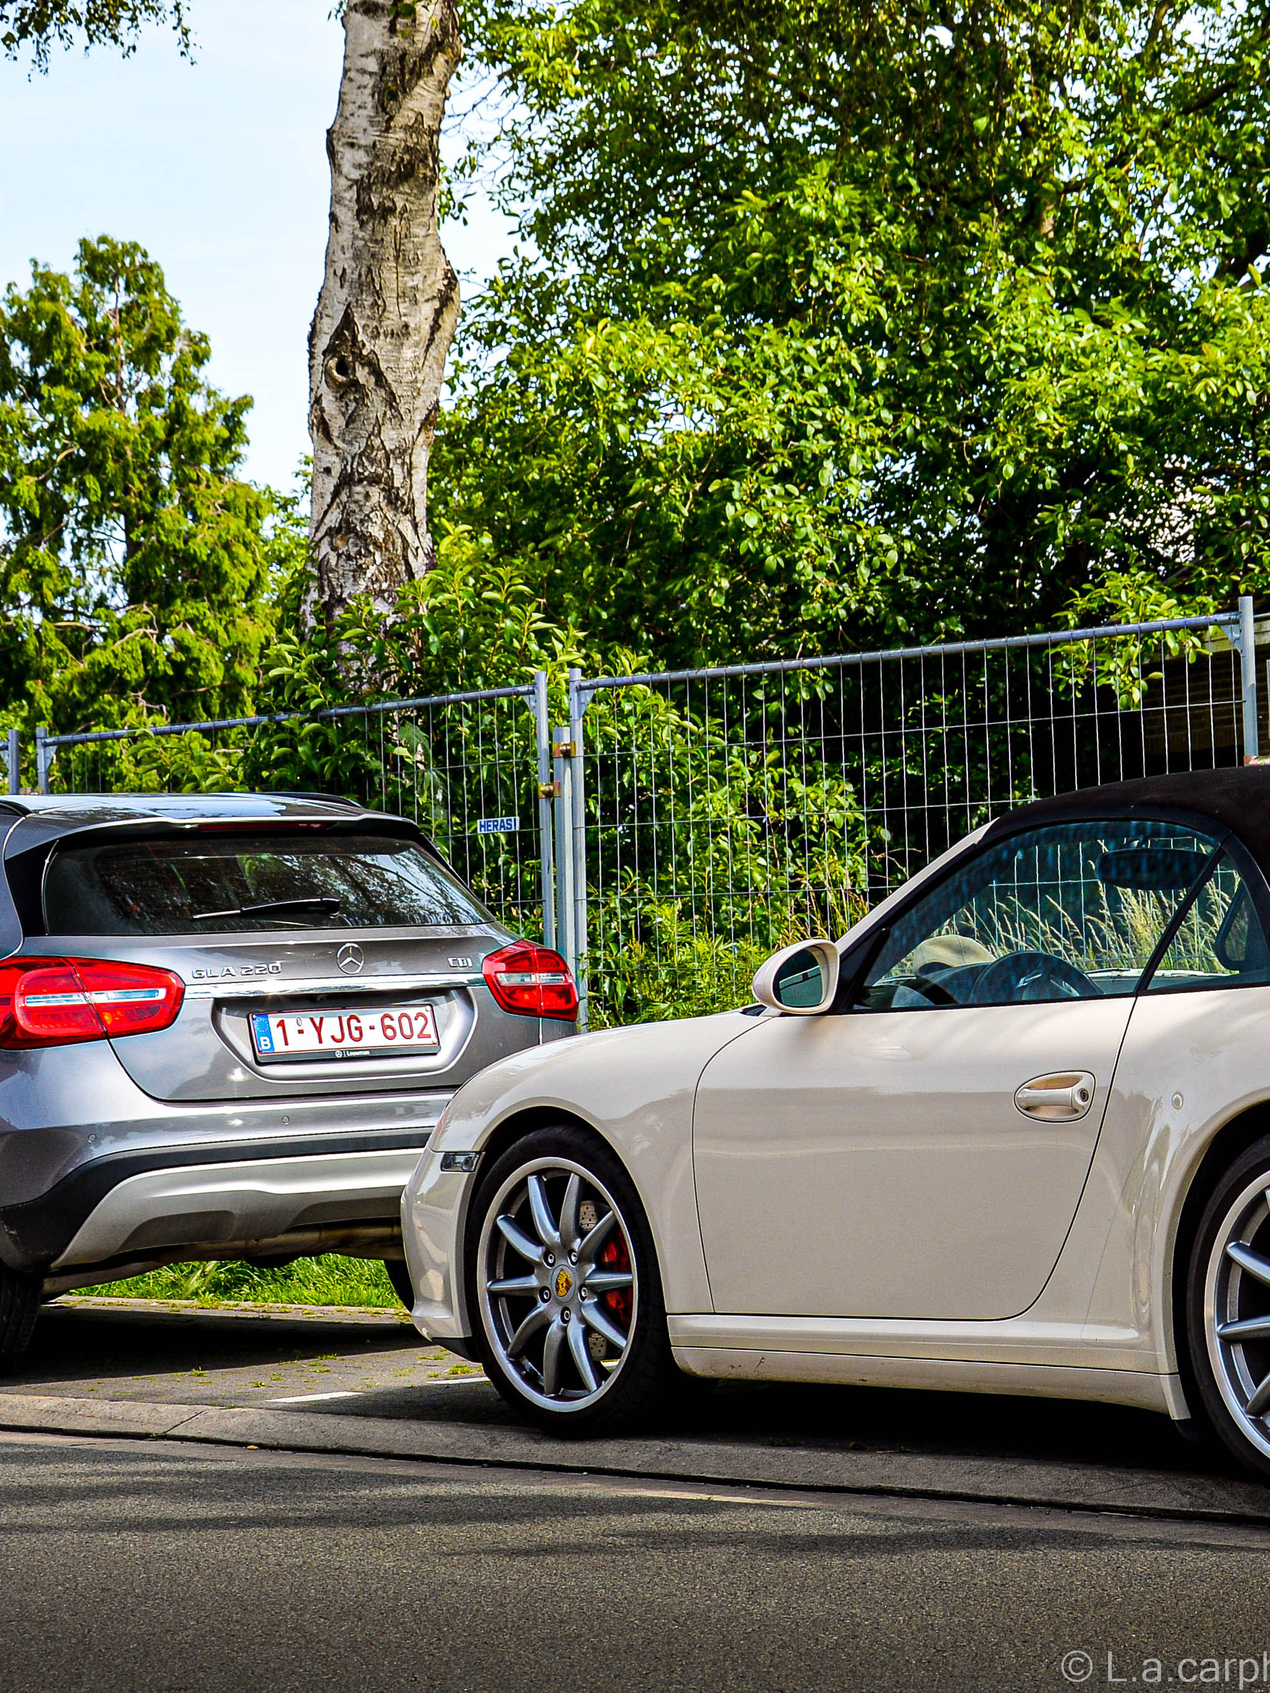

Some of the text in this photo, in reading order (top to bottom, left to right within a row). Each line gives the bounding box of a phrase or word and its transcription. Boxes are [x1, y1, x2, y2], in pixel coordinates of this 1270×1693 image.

[191, 962, 282, 979] GLA 220
[447, 957, 473, 969] CDI
[276, 1012, 432, 1046] 1-YJG-602
[259, 1036, 271, 1050] B
